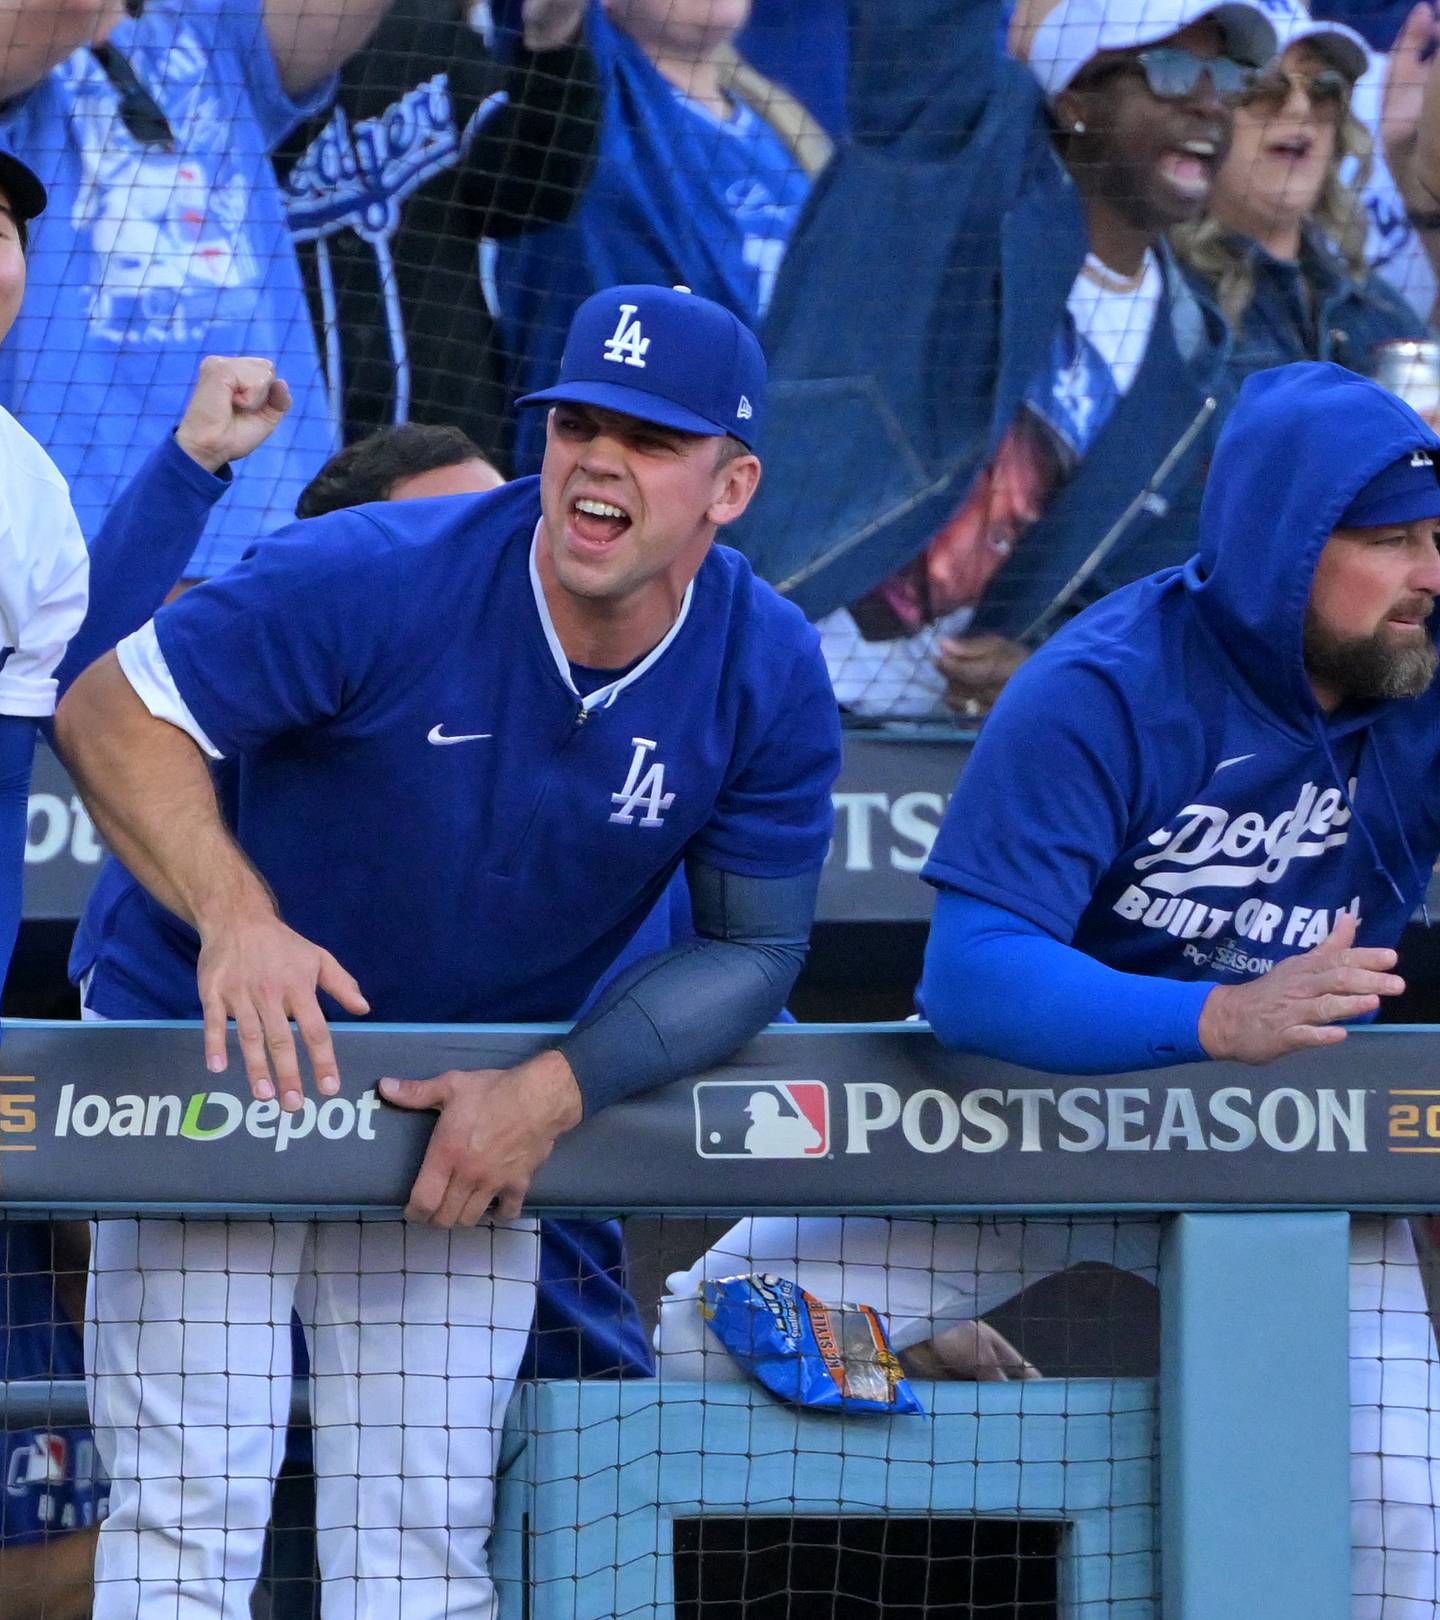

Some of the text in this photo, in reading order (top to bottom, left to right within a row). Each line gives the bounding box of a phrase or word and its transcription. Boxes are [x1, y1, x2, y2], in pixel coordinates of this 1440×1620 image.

[603, 304, 650, 368] LA
[608, 737, 676, 827] LA
[1112, 884, 1234, 939] BUILT
[1234, 898, 1284, 943] OR
[54, 1083, 381, 1152] loanDepot
[843, 1082, 1368, 1154] POSTSEASON
[812, 1313, 834, 1349] STYLE
